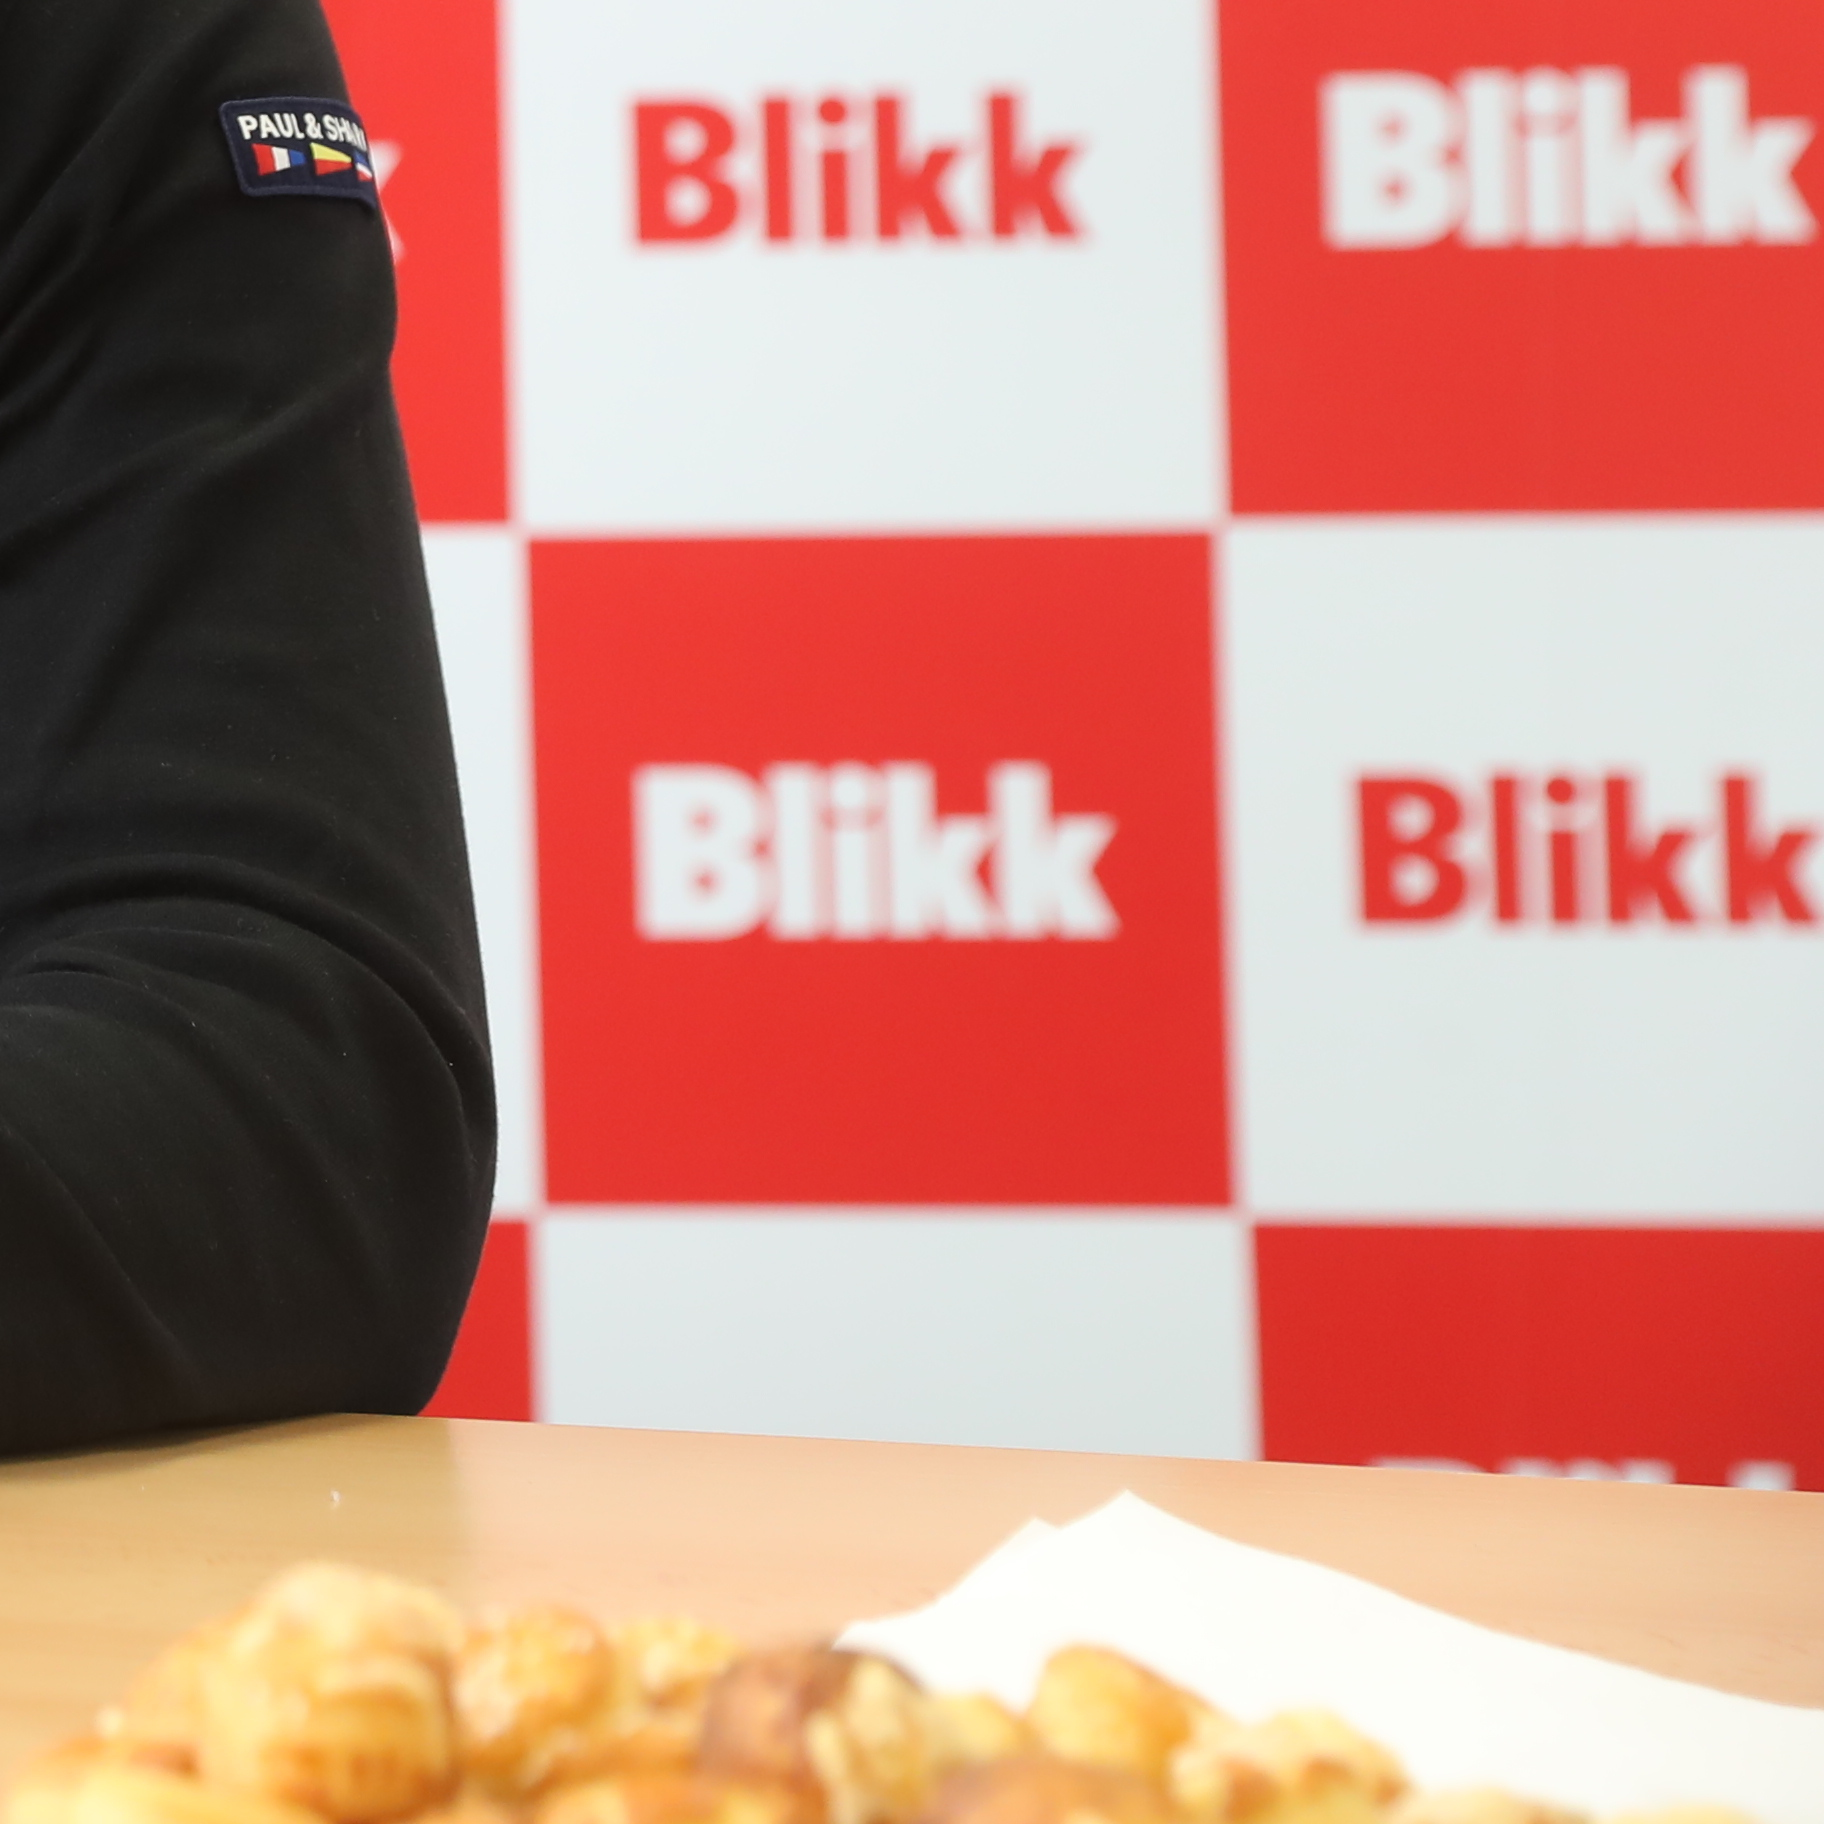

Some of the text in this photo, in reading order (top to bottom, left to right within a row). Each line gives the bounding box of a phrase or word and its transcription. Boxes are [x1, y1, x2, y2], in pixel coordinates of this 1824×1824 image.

[237, 113, 305, 140] PAUL
[303, 112, 323, 139] &
[634, 94, 1076, 244] Blikk
[1323, 67, 1813, 247] Blikk
[636, 764, 1114, 938] Blikk
[1358, 775, 1815, 925] Blikk
